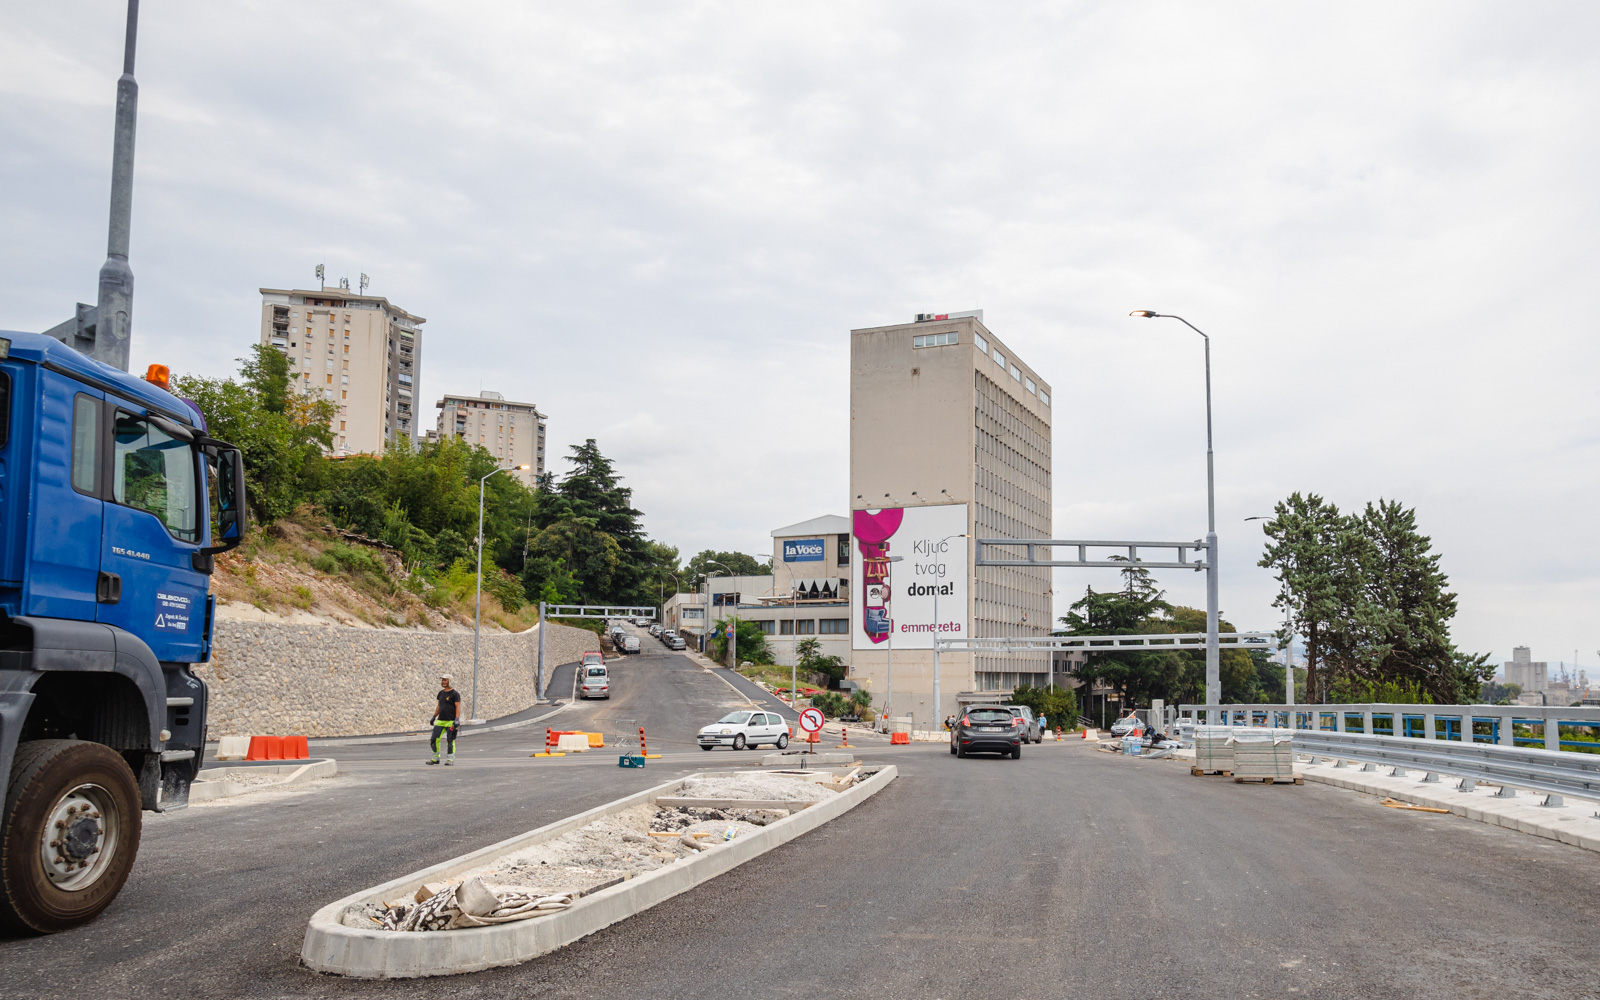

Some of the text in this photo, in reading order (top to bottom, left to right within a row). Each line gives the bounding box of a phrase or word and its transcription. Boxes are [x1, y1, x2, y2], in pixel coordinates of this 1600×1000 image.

[126, 549, 150, 560] 41.440
[914, 562, 946, 578] tvog
[907, 582, 954, 596] doma!
[901, 620, 961, 633] emmezeta
